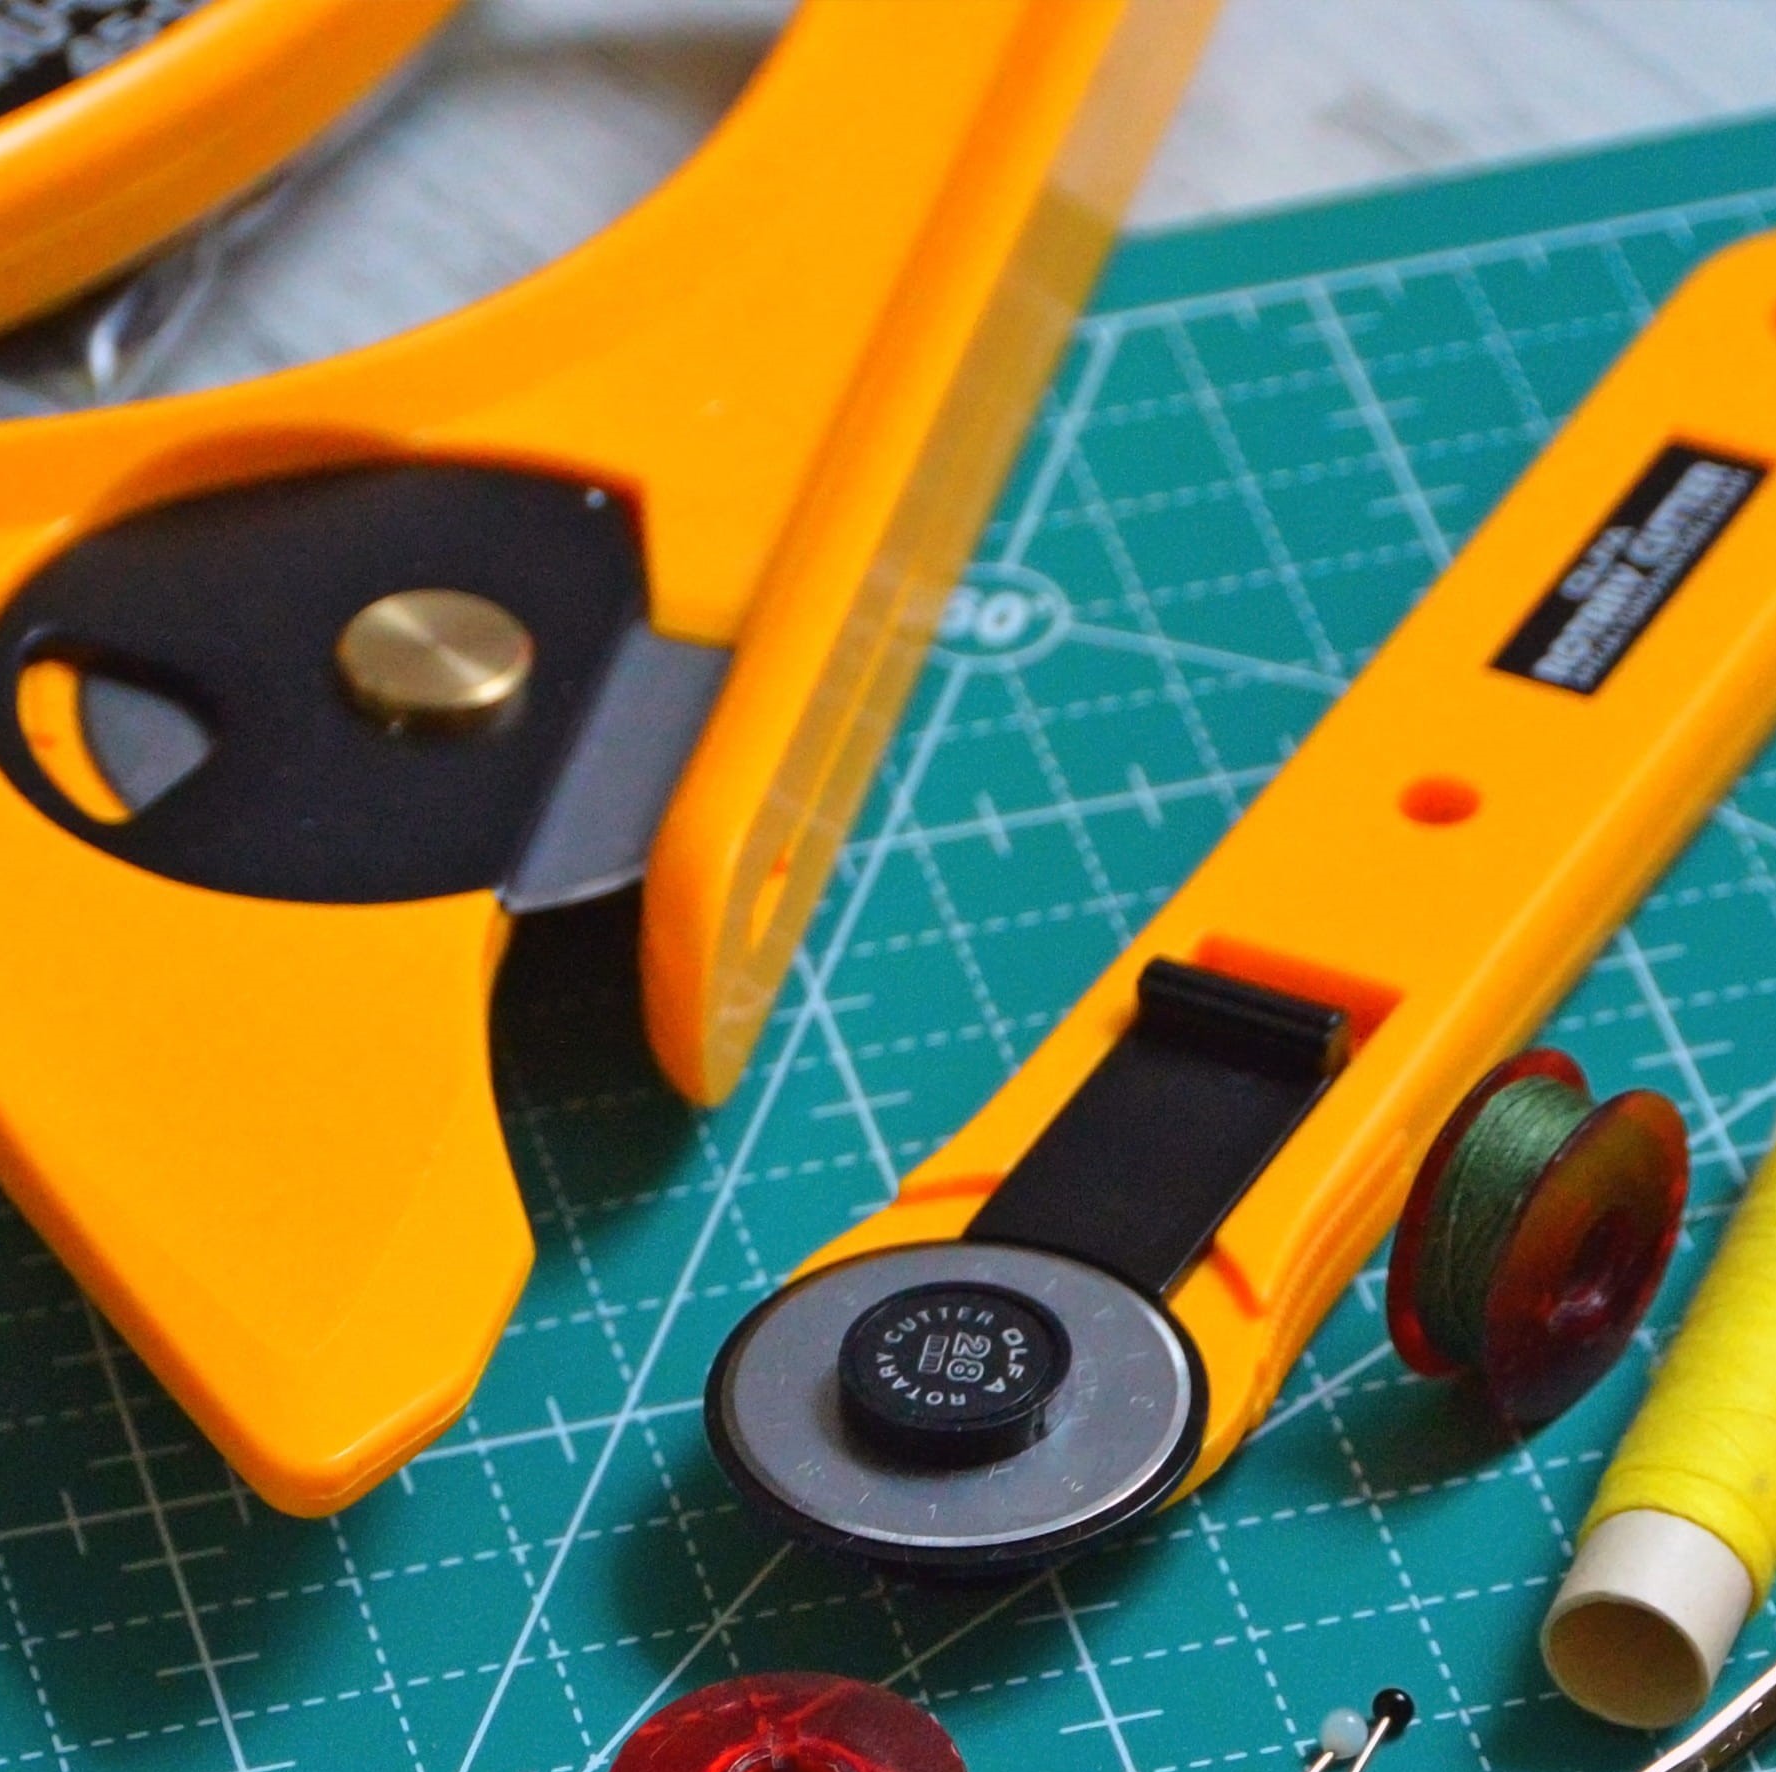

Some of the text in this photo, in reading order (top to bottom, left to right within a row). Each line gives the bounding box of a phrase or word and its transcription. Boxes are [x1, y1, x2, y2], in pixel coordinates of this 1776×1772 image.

[884, 1306, 994, 1344] CUTTER
[876, 1352, 967, 1406] ROTARY
[946, 1331, 992, 1383] 28
[983, 1327, 1028, 1393] OLFA
